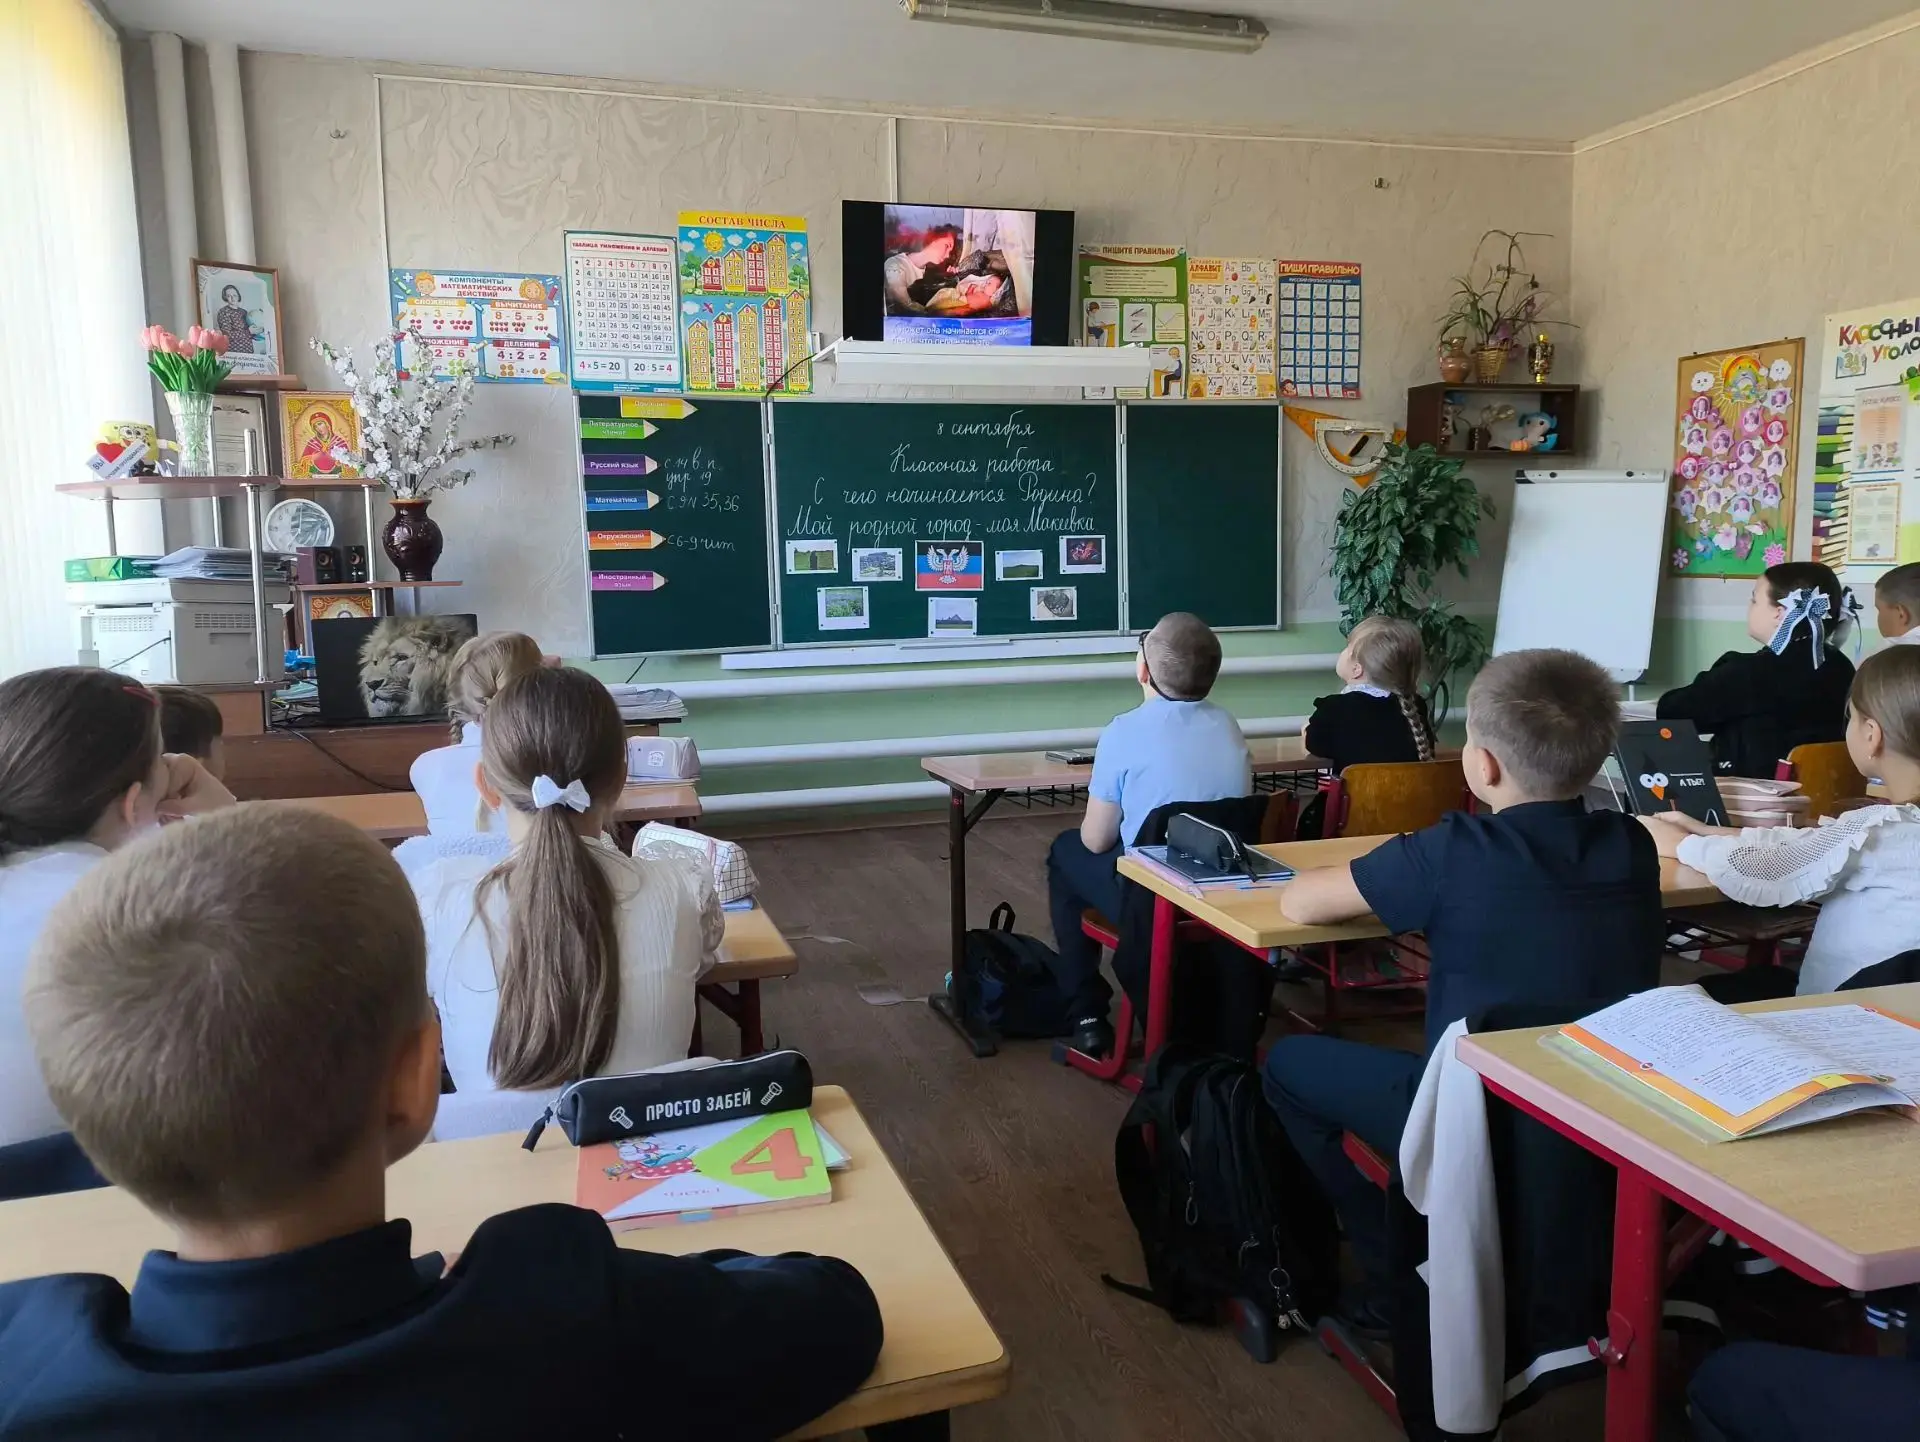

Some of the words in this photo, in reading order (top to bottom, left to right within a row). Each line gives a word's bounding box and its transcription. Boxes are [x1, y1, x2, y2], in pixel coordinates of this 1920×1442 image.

[699, 216, 743, 225] СОСТАВ
[748, 218, 786, 228] ЧИСЛА
[1280, 263, 1308, 272] ПИШИ
[1308, 264, 1359, 274] ПРАВИЛЬНО
[441, 284, 512, 292] МАТЕМАТИЧЕСКИХ
[457, 290, 498, 298] ДЕЙСТВИЙ
[496, 312, 502, 320] 8
[515, 312, 521, 320] 5
[498, 351, 504, 359] 4
[609, 362, 620, 370] 20
[634, 363, 645, 371] 20
[652, 364, 657, 372] 5
[589, 420, 639, 428] Литературное
[937, 422, 944, 435] 8
[952, 409, 1035, 448] сентября
[889, 442, 978, 473] Классная
[985, 447, 1054, 482] работа
[815, 477, 825, 504] С
[843, 490, 876, 504] чего
[885, 488, 1006, 504] начинается
[787, 505, 833, 535] Мой
[848, 517, 918, 554] родной
[926, 518, 971, 541] город
[987, 518, 1020, 532] моя
[646, 1099, 700, 1121] ПРОСТО
[706, 1088, 751, 1111] ЗАБЕЙ
[730, 1127, 813, 1181] 4
